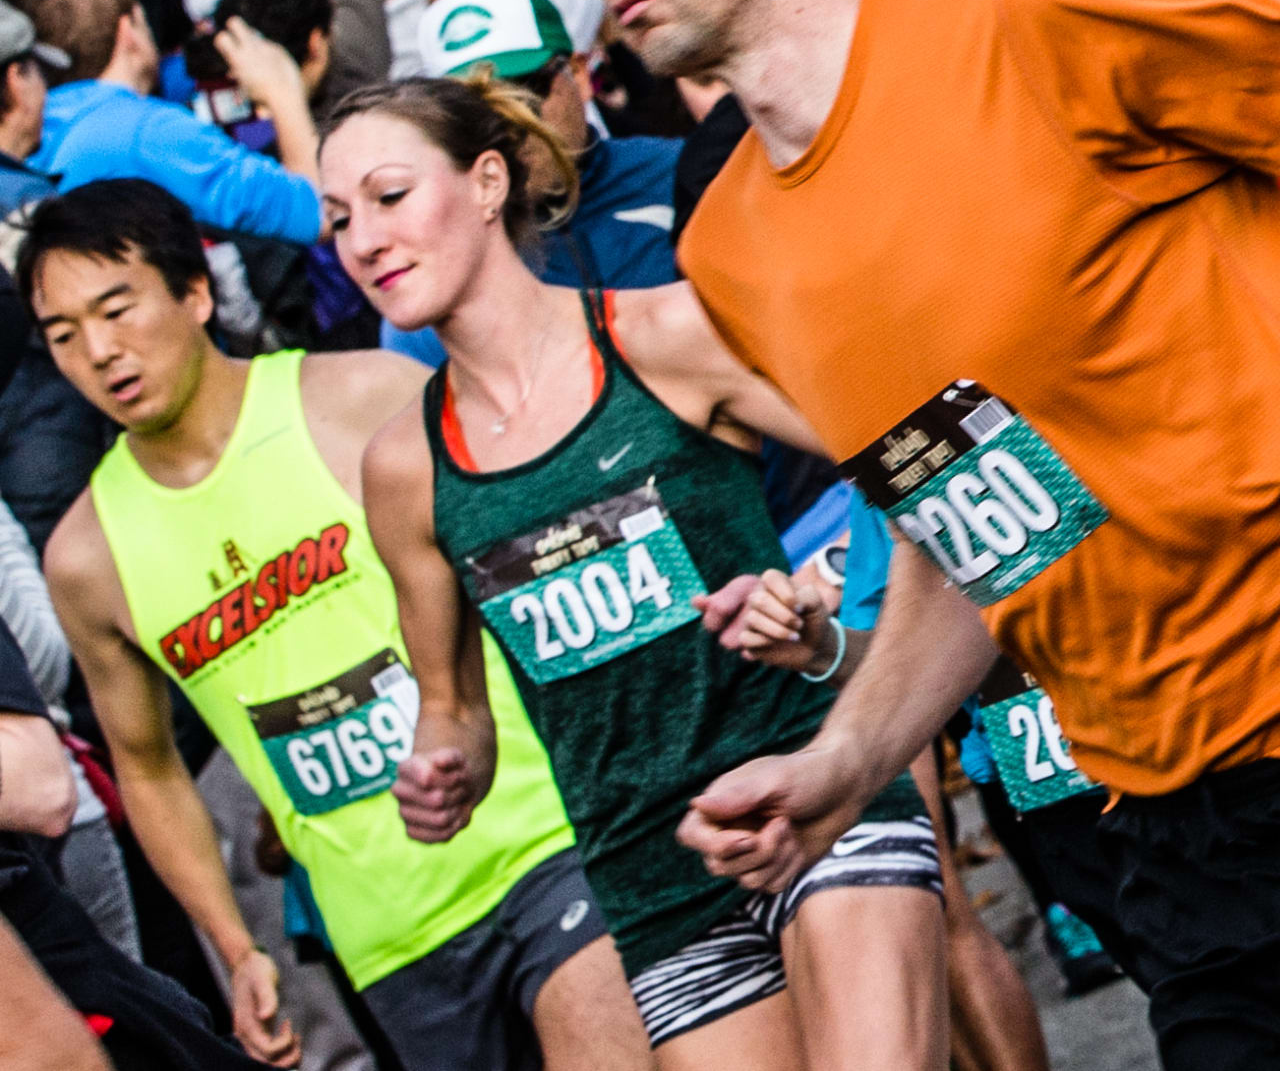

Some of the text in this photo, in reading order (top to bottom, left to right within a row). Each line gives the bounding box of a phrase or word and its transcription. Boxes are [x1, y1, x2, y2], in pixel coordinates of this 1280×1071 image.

[158, 521, 351, 680] EXCELSIOR
[509, 542, 674, 662] 2004
[286, 701, 415, 797] 6769
